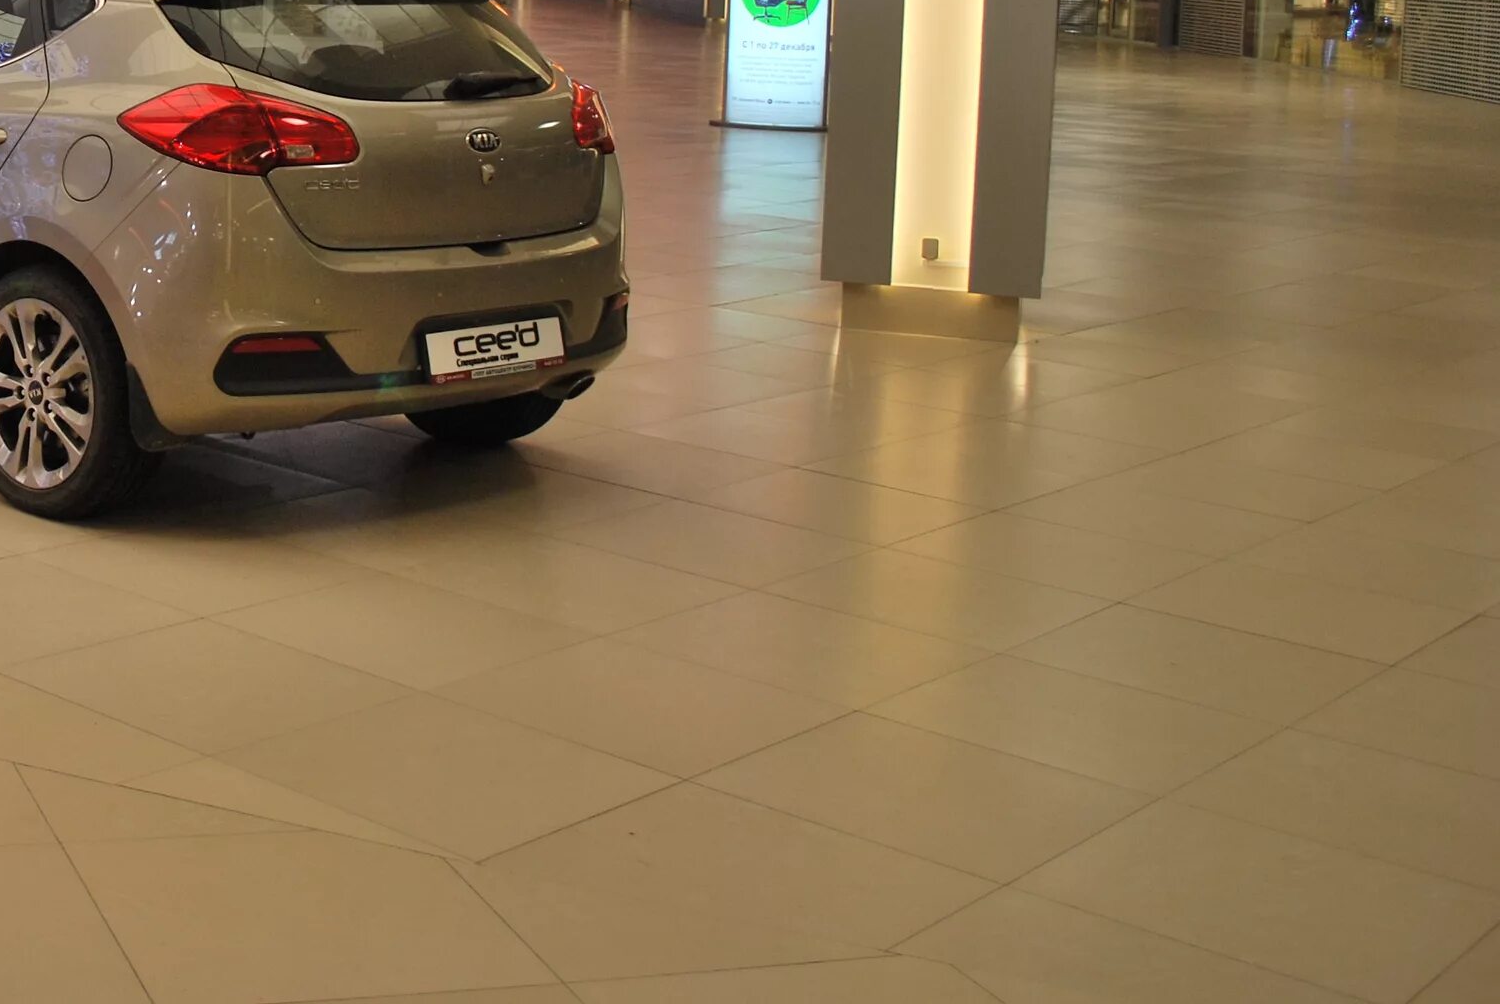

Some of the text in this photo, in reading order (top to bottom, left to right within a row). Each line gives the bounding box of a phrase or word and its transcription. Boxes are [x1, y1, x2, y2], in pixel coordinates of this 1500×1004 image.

[781, 43, 815, 52] декабря
[471, 133, 500, 149] KIA
[453, 321, 540, 357] cee'd
